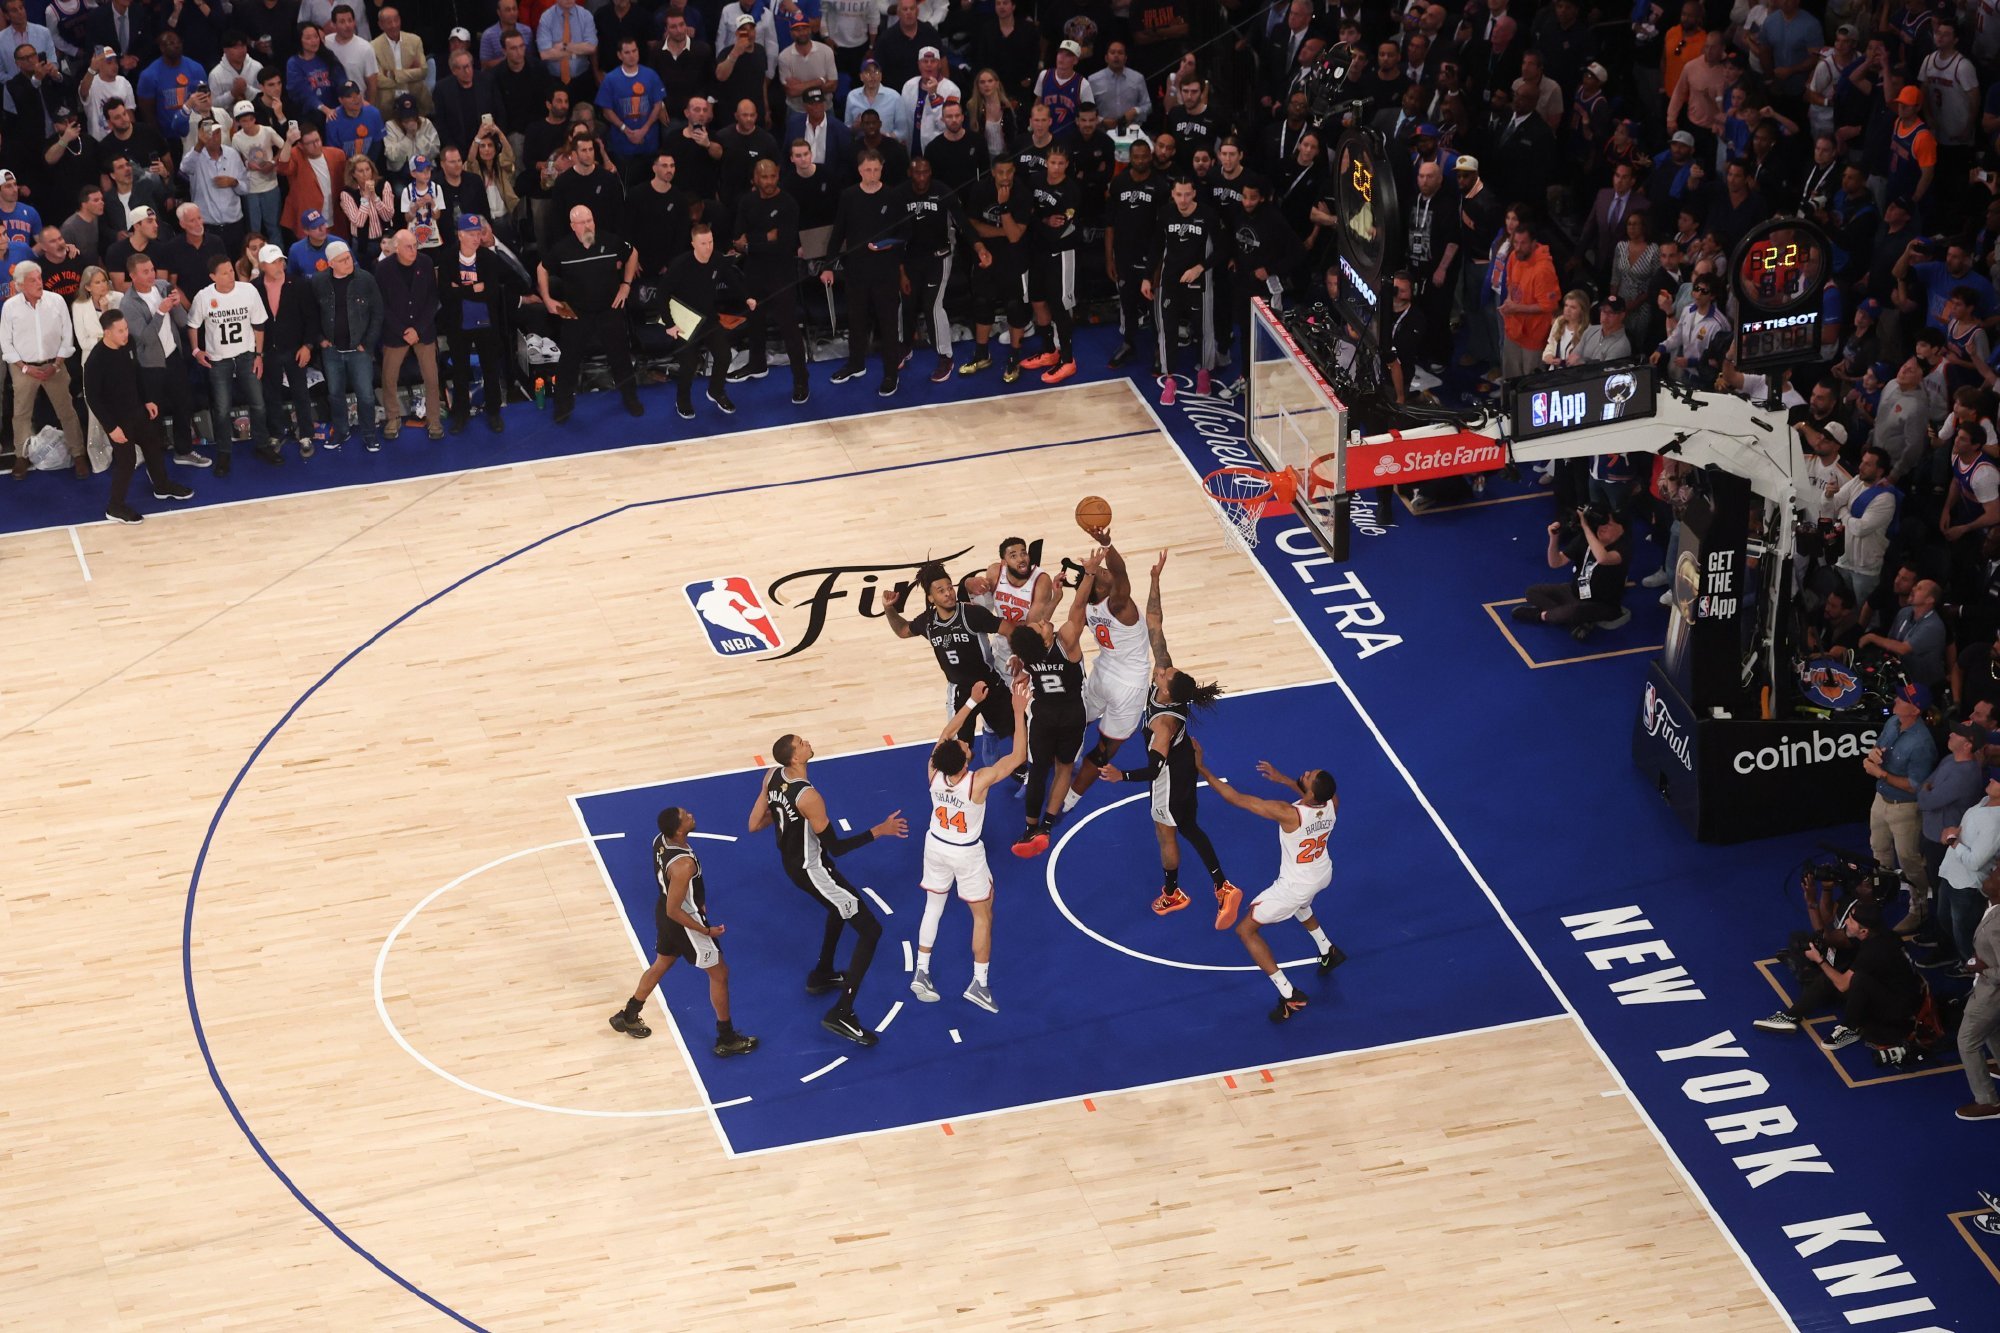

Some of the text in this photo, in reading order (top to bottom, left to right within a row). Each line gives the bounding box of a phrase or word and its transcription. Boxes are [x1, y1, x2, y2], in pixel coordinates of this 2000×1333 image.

[1055, 107, 1067, 122] 7
[44, 271, 61, 290] NEW
[208, 306, 249, 318] McDONALD'S
[1764, 312, 1818, 330] TISSOT
[219, 322, 243, 345] 12
[1550, 390, 1587, 427] App
[1708, 550, 1735, 572] GET
[1275, 526, 1404, 660] ULTRA
[1707, 571, 1733, 594] THE
[1000, 604, 1025, 622] 32
[1709, 597, 1737, 620] App
[720, 636, 757, 653] NBA
[931, 632, 970, 649] SPURS
[945, 650, 960, 665] 5
[1030, 662, 1064, 672] HARPER
[1040, 674, 1066, 693] 2
[1648, 698, 1693, 772] Finals
[1733, 729, 1878, 775] coinbas
[934, 790, 966, 810] SHAMET
[934, 806, 968, 834] 44
[1295, 831, 1329, 864] 25
[1560, 904, 1955, 1333] NEW YORK KNI
